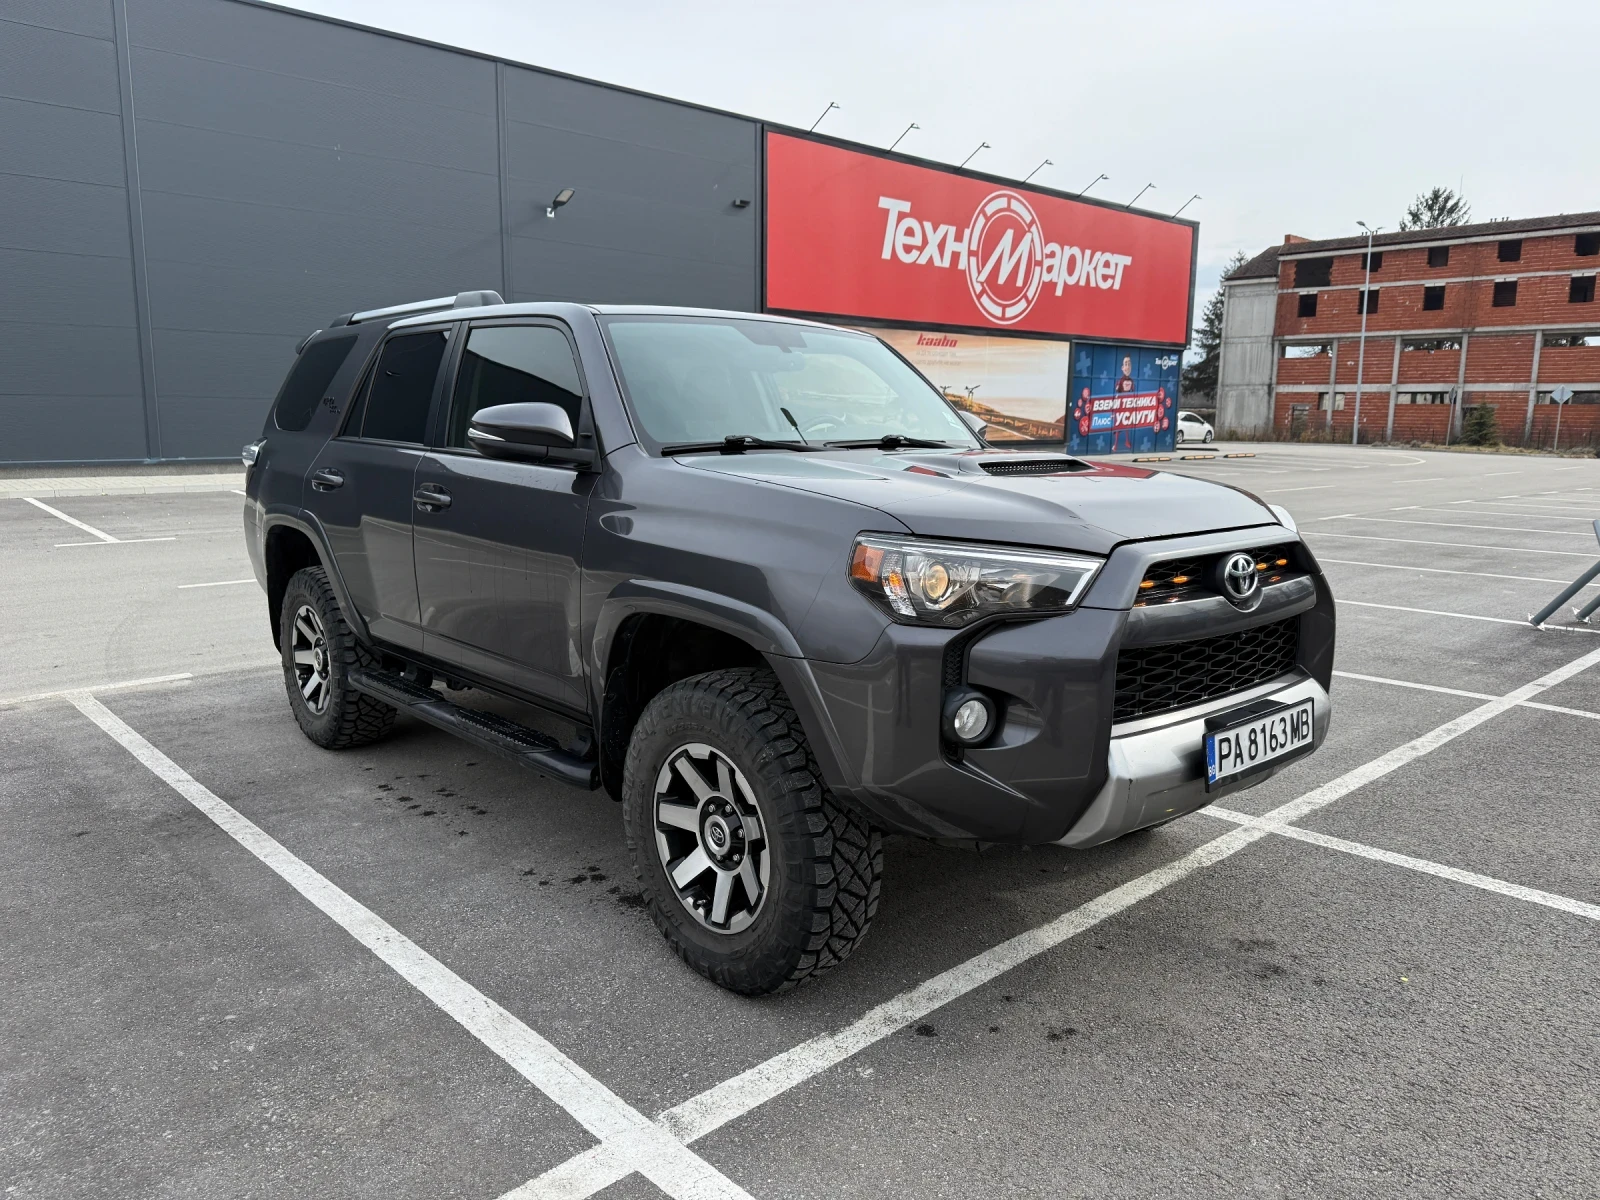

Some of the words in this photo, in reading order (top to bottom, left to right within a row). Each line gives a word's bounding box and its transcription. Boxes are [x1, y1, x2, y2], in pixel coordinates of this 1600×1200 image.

[917, 332, 958, 348] kaabo
[1121, 396, 1157, 409] ТЕХНИКА
[1115, 410, 1156, 426] УСЛУГИ
[1218, 732, 1244, 773] PA
[1248, 716, 1288, 761] 8163
[1290, 708, 1310, 746] MB
[1208, 764, 1216, 778] BG
